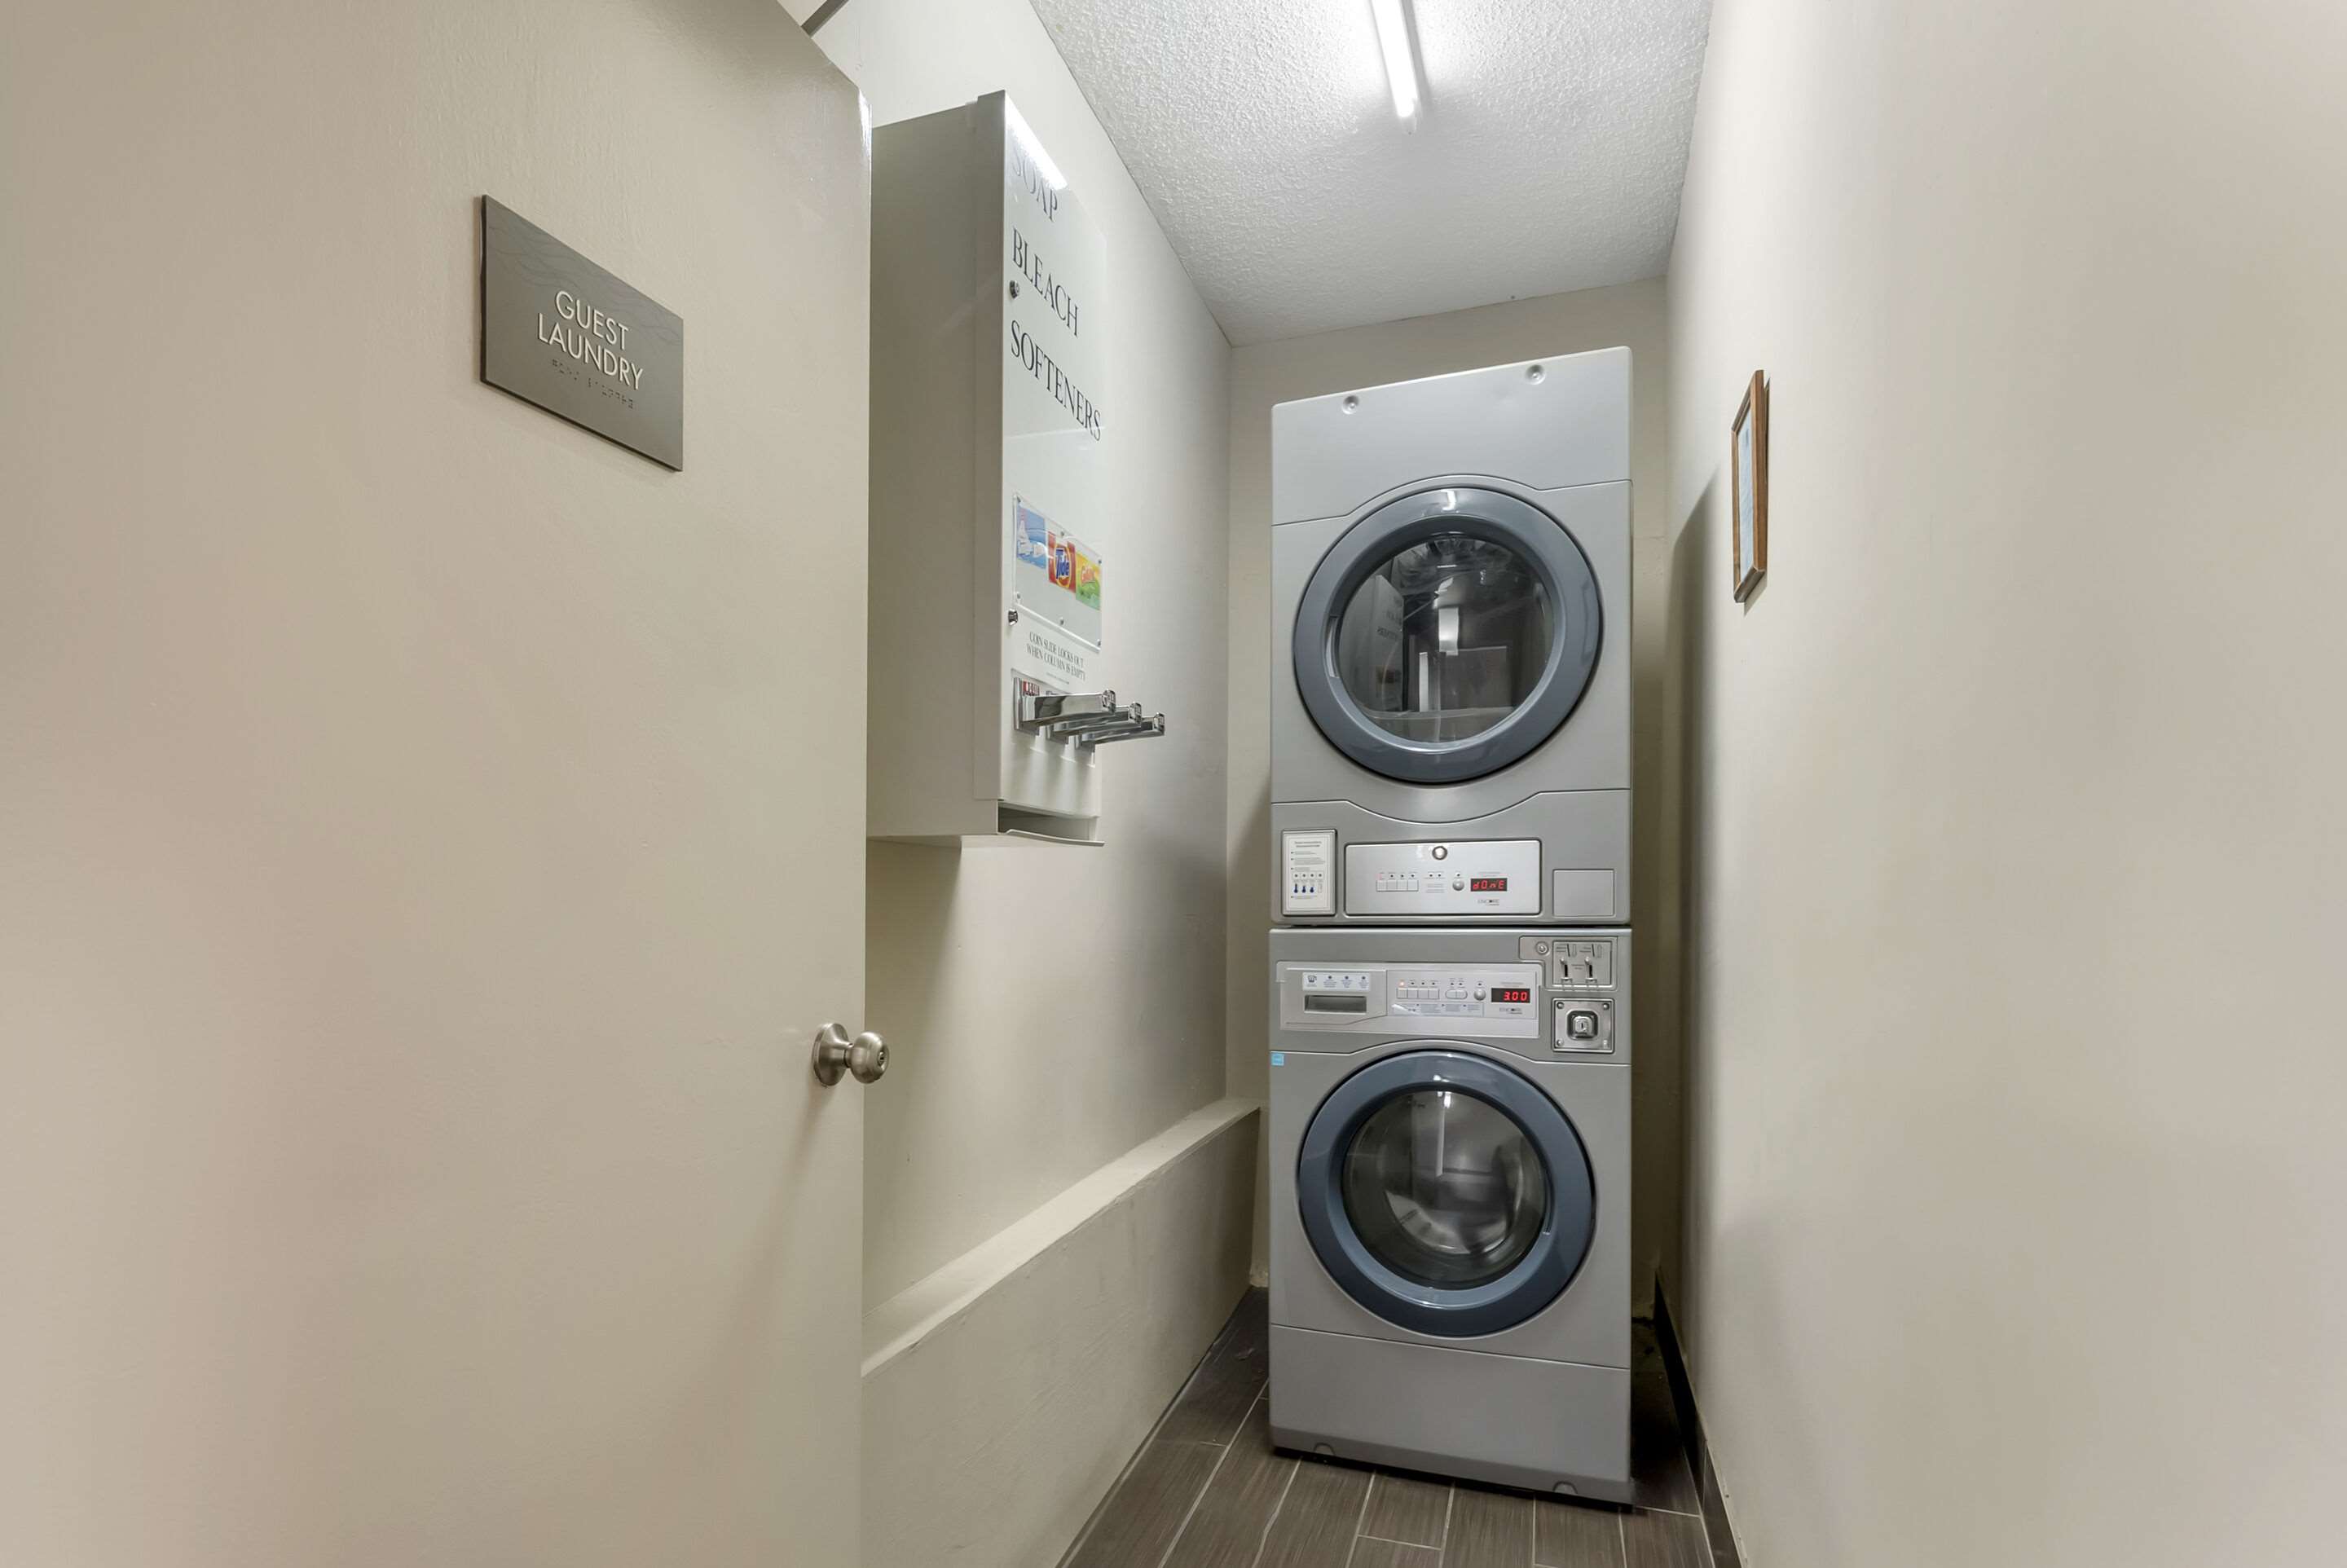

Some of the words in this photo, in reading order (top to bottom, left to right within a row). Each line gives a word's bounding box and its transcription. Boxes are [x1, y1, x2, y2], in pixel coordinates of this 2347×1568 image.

[556, 291, 629, 350] GUEST
[1012, 227, 1079, 337] BLEACH
[539, 313, 643, 390] LAUNDRY
[1011, 319, 1101, 442] SOFTENERS
[1055, 548, 1070, 580] Tide
